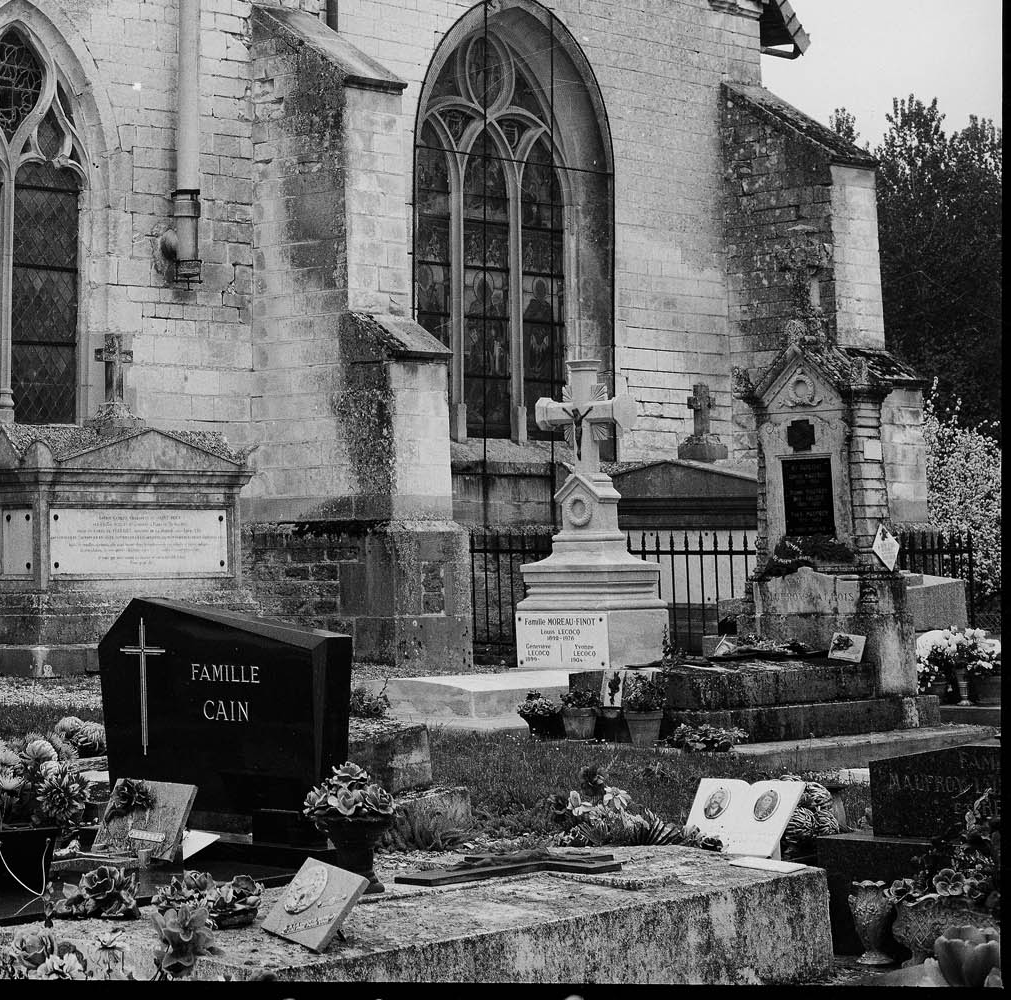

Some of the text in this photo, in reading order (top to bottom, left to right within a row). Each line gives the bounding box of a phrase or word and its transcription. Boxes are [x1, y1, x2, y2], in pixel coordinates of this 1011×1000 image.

[525, 618, 595, 626] Famille MOREAU-FINOT
[573, 650, 597, 658] LECOCQ
[191, 664, 260, 683] FAMILLE
[203, 699, 249, 722] CAIN
